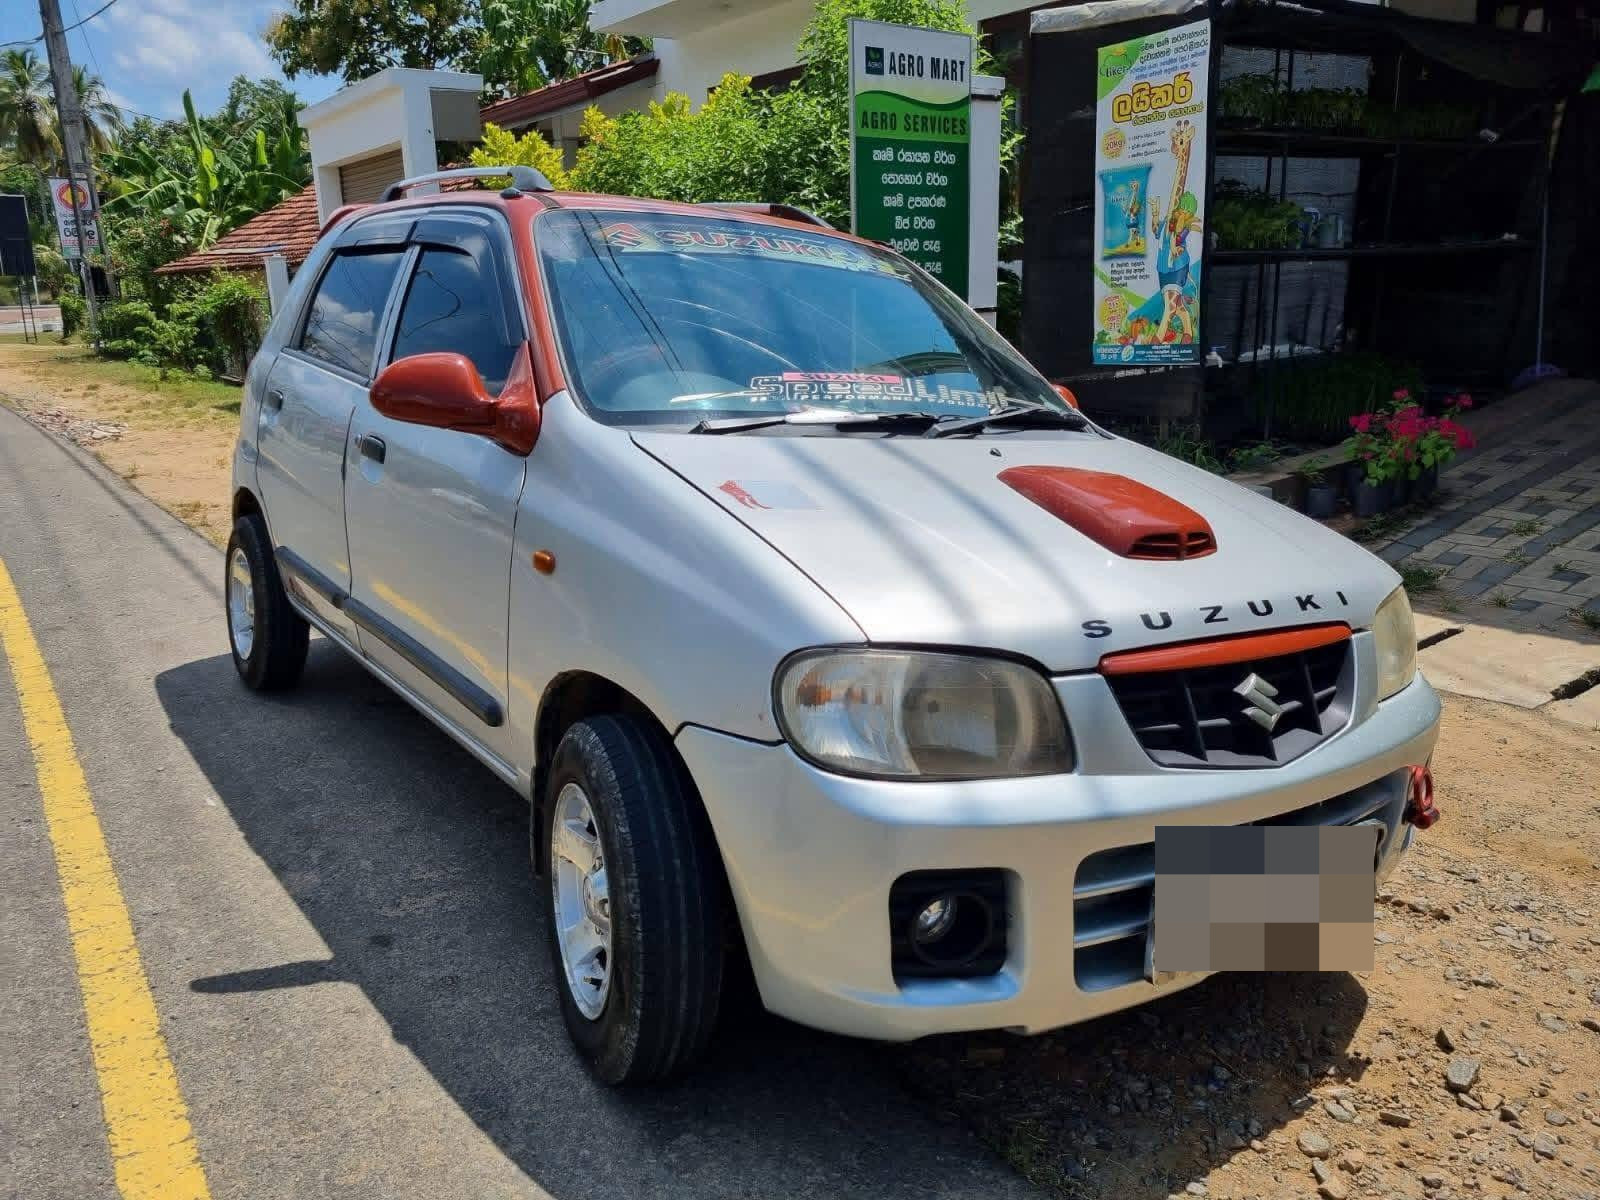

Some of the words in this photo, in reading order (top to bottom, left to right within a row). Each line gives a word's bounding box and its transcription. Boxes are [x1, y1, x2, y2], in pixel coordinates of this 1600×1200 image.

[888, 51, 924, 78] AGRO
[930, 56, 966, 82] MART
[861, 110, 897, 131] AGRO
[903, 112, 967, 136] SERVICES
[654, 229, 834, 259] SUZUKI
[800, 373, 886, 384] SUZUKI
[800, 394, 922, 402] PERFORMANCE
[1081, 591, 1349, 639] SUZUKI
